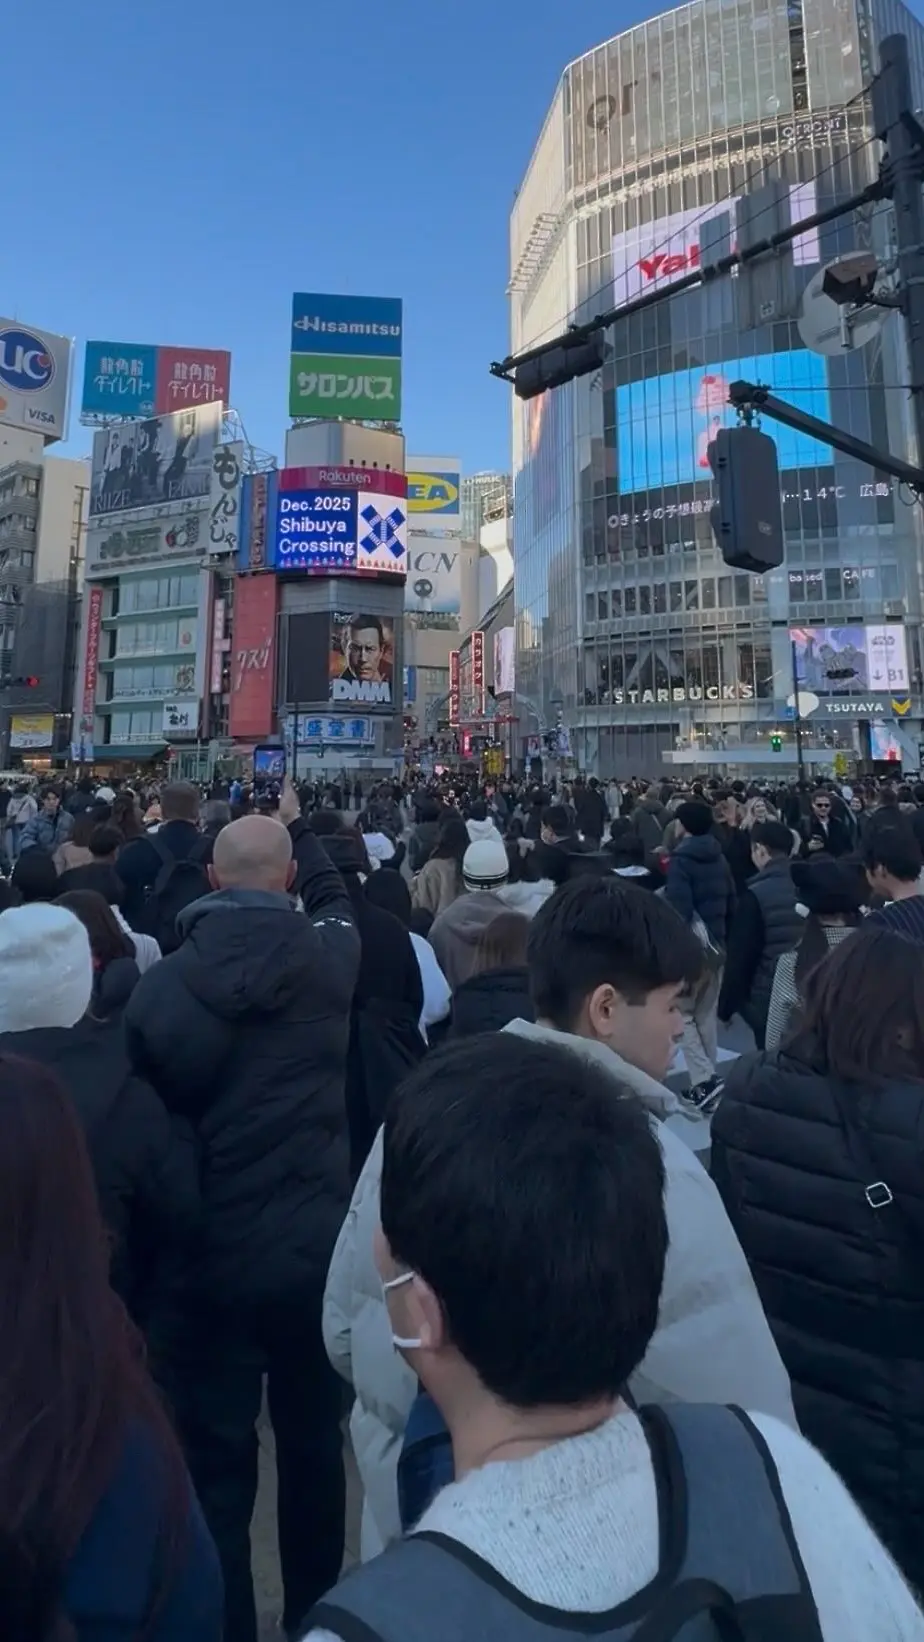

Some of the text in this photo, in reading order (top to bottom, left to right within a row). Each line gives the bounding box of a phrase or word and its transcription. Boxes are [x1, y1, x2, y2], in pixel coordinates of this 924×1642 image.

[294, 315, 400, 336] Hisamitsu
[297, 371, 394, 399] サロンパス
[28, 408, 55, 424] VISA
[319, 470, 371, 485] Rakuten
[208, 446, 239, 549] もんじゃ
[281, 496, 351, 513] Dec. 2025
[280, 516, 346, 534] Shibuya
[279, 537, 355, 556] Crossing
[333, 679, 391, 701] DMM
[615, 685, 754, 704] STARBUCKS
[826, 703, 884, 713] TSUTAYA
